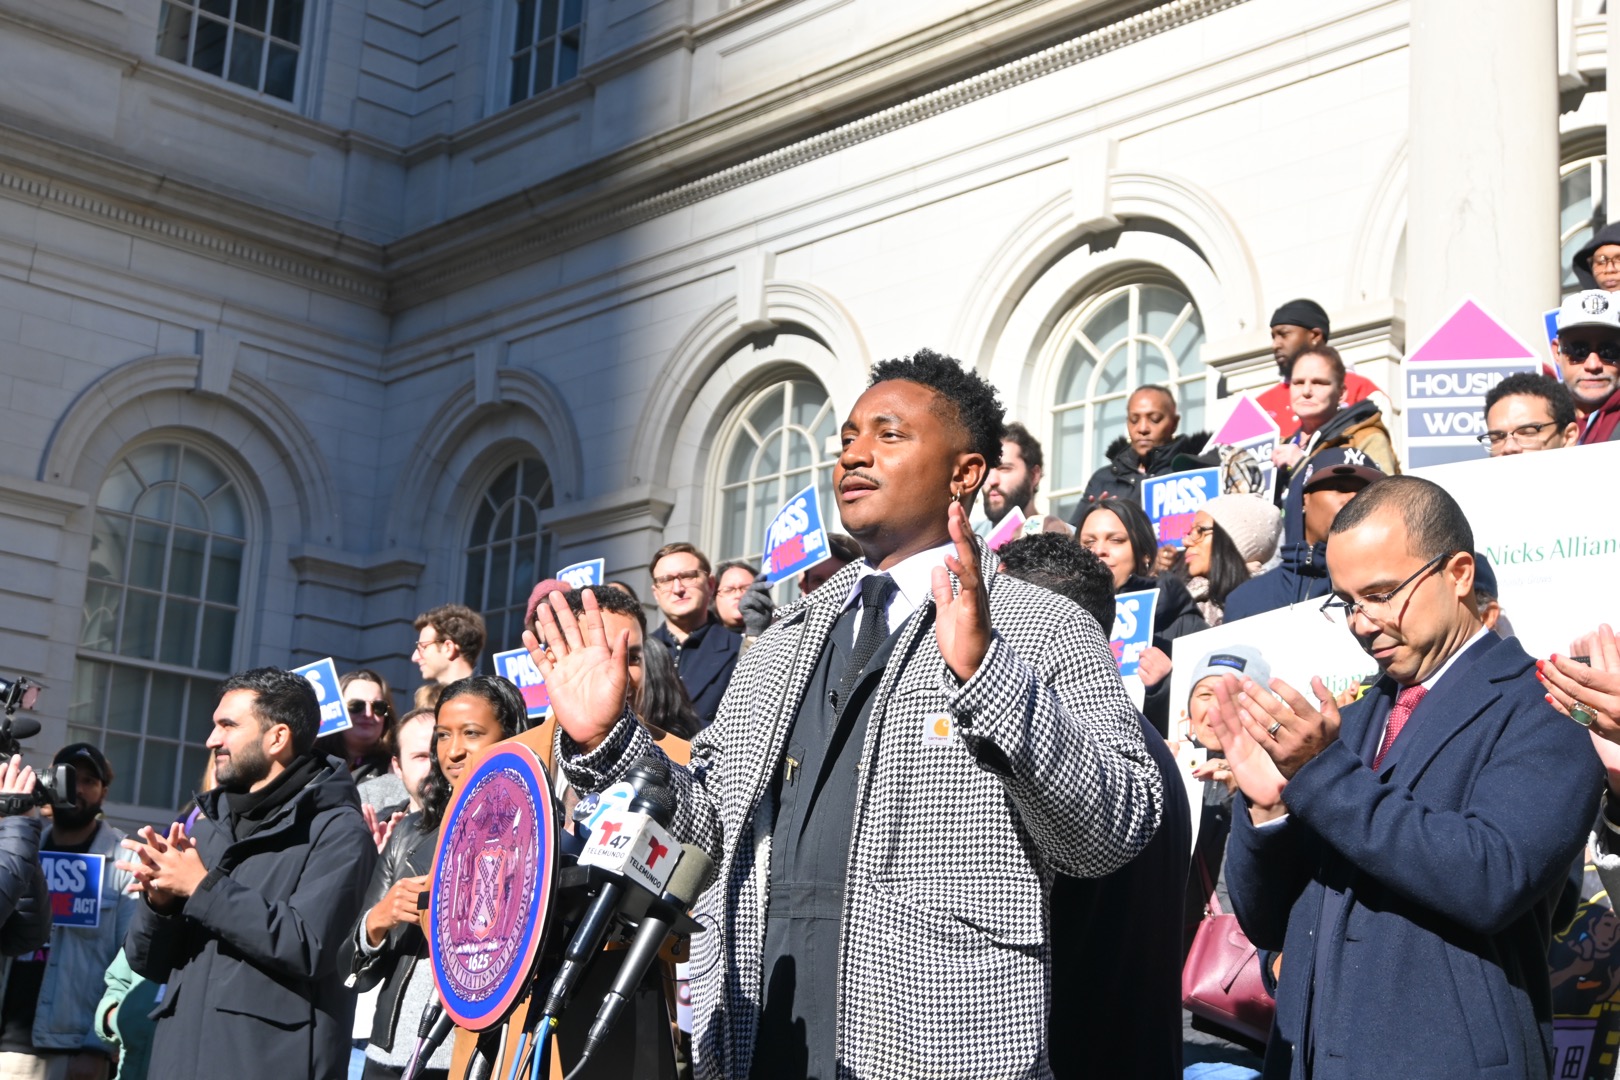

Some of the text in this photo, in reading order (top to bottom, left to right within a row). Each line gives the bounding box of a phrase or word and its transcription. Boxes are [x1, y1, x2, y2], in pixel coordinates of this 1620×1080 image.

[1410, 372, 1513, 396] HOUSI
[1423, 412, 1488, 434] WOR
[1152, 476, 1206, 519] PASS
[1486, 536, 1620, 565] Nicks Allian
[1110, 599, 1140, 641] SS
[505, 653, 544, 687] PAS
[574, 798, 597, 814] abc
[587, 847, 626, 859] TELEMUNDO
[609, 836, 631, 849] 47
[42, 858, 87, 893] ASS
[629, 856, 662, 889] TELEMUNDO
[73, 897, 96, 914] ACT
[468, 953, 489, 971] 1625
